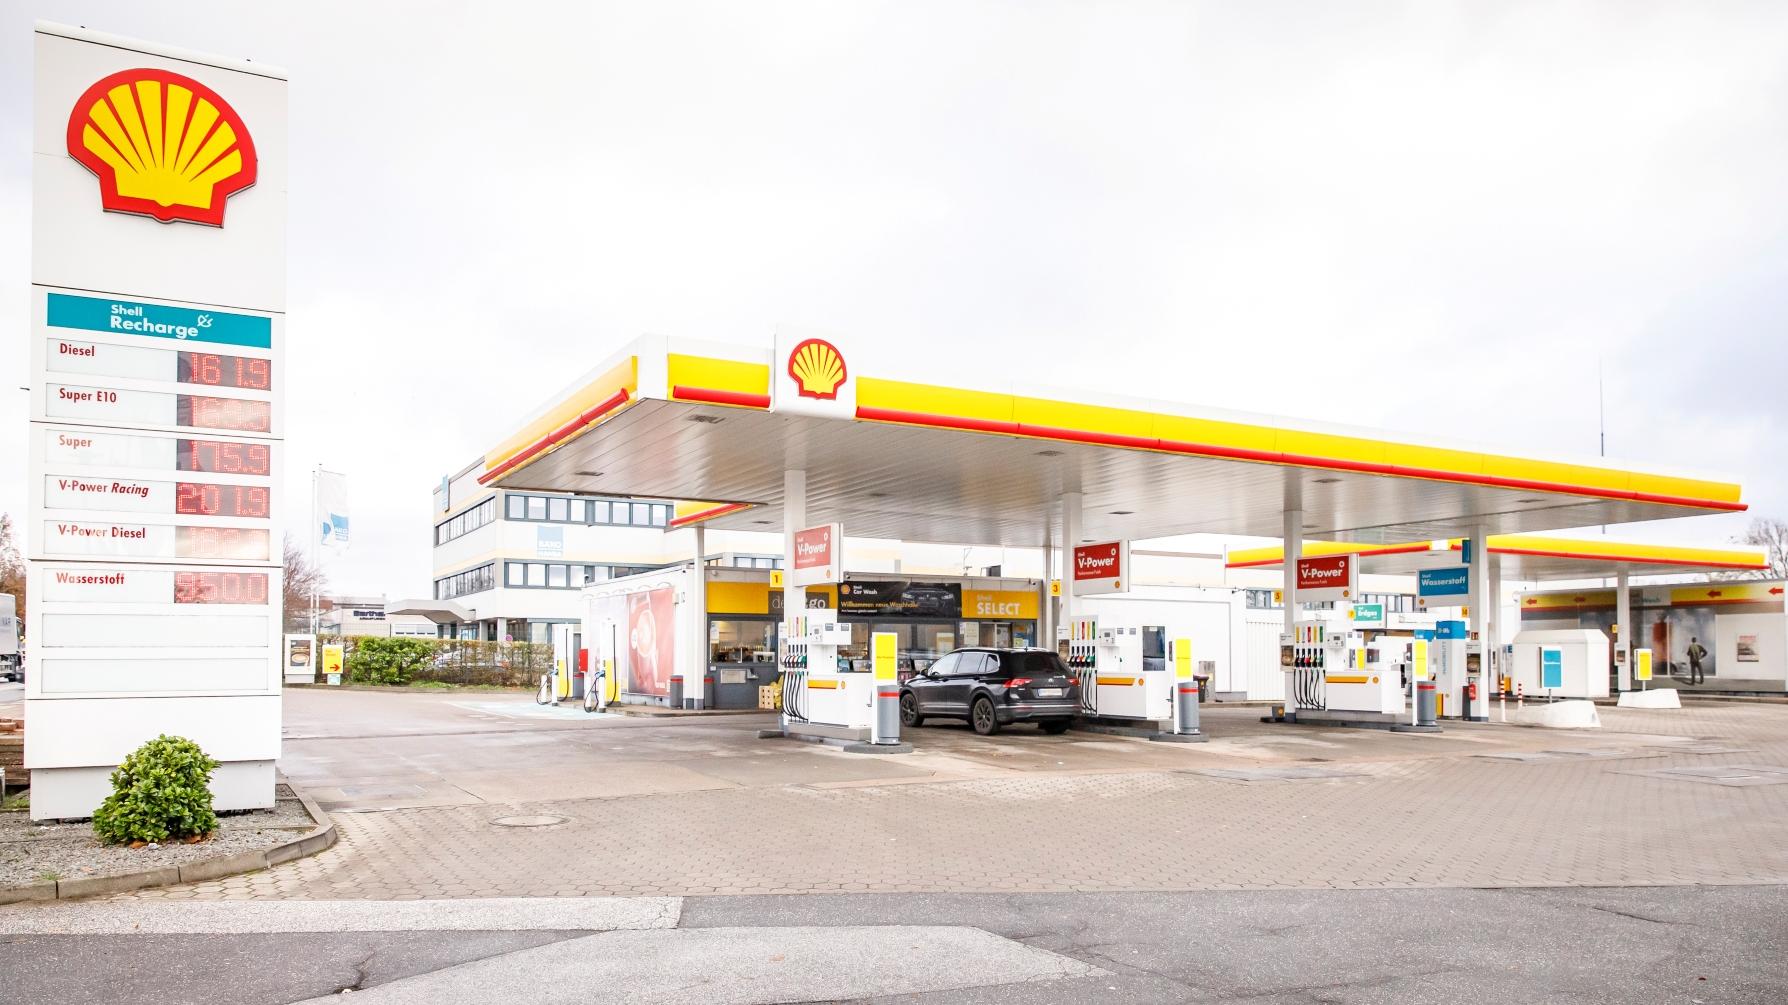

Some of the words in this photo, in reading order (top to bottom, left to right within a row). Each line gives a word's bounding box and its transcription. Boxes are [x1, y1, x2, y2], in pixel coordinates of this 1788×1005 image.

[111, 304, 143, 317] Shell
[110, 316, 199, 339] Recharge
[59, 343, 95, 357] Diesel
[59, 388, 92, 403] Super
[97, 391, 117, 403] E10
[59, 434, 93, 449] Super
[58, 479, 108, 493] V-Power
[111, 482, 149, 498] Racing
[58, 524, 108, 537] V-Power
[111, 527, 146, 539] Diesel
[797, 543, 827, 556] V-Power
[1078, 557, 1115, 568] V-Power
[56, 572, 125, 585] Wasserstoff
[774, 574, 779, 584] 1
[1301, 568, 1343, 579] V-Power
[1421, 575, 1466, 587] Wasserstoff
[1053, 584, 1058, 593] 3
[841, 600, 875, 608] Willkommen
[976, 602, 1021, 615] SELECT
